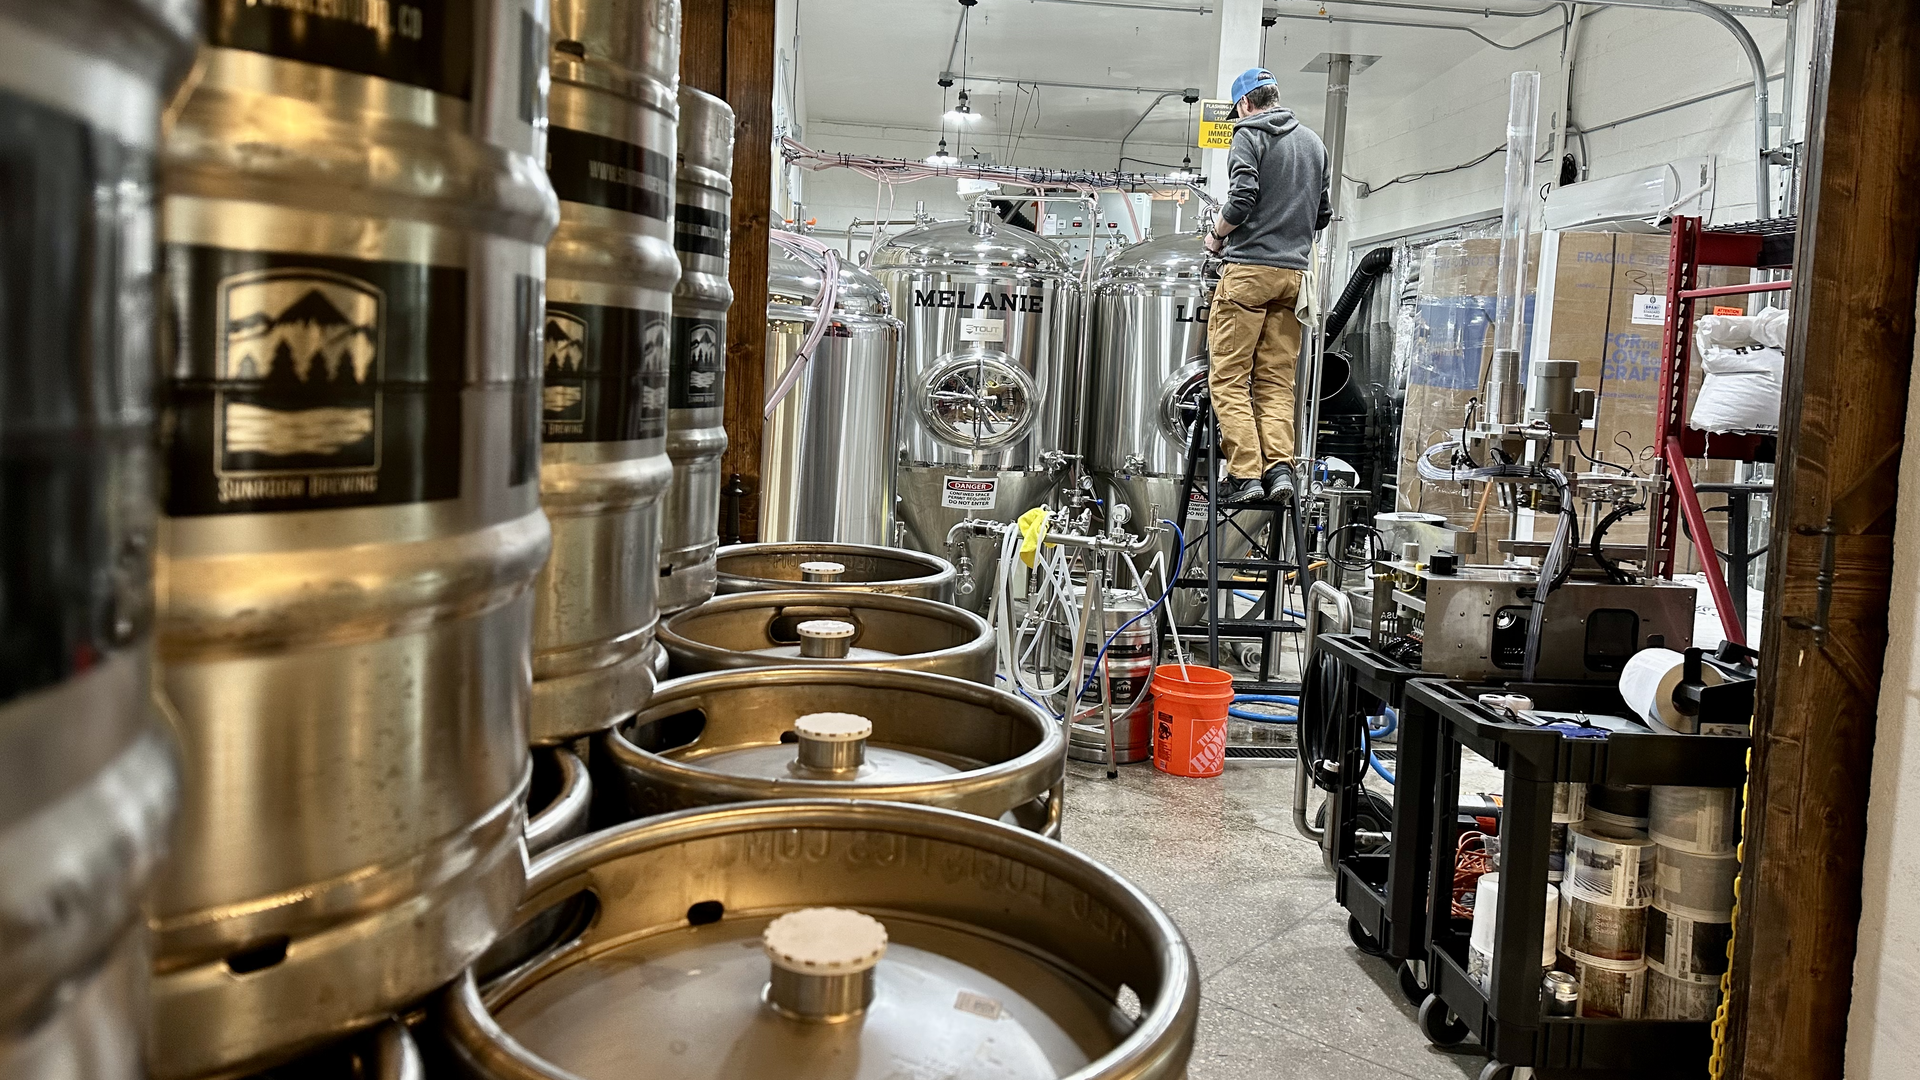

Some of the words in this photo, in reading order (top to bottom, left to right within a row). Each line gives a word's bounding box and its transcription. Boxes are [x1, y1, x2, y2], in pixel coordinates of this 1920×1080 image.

[915, 289, 1044, 313] MELANIE
[966, 324, 999, 334] STOUT
[1605, 332, 1642, 348] FOR
[1641, 341, 1659, 349] THE
[1604, 364, 1661, 381] CRAFT
[550, 423, 584, 435] BREWING
[1196, 725, 1219, 748] THE
